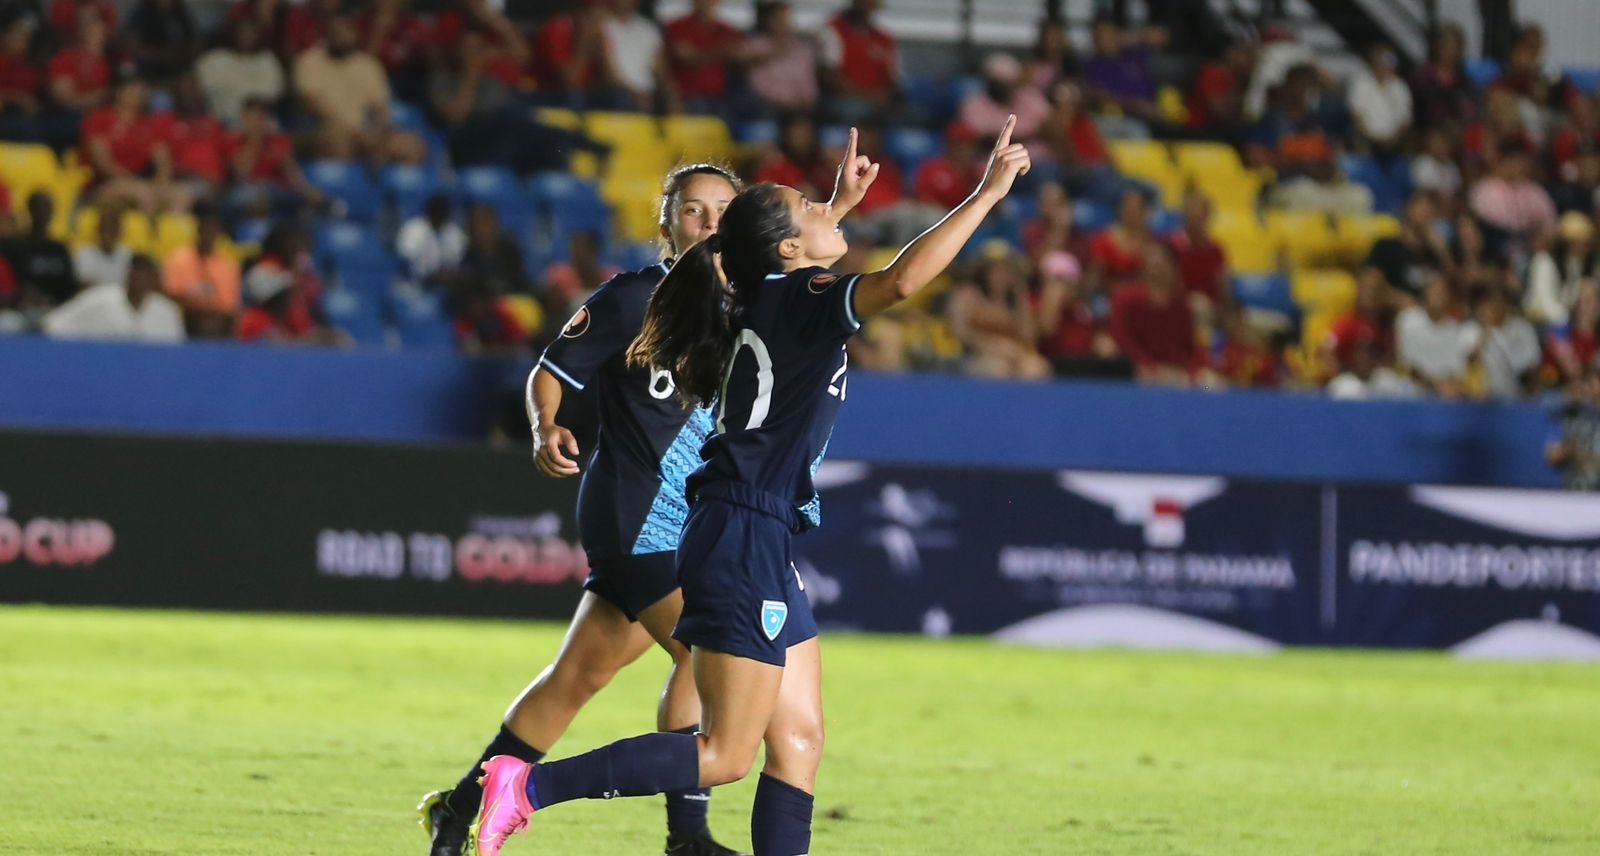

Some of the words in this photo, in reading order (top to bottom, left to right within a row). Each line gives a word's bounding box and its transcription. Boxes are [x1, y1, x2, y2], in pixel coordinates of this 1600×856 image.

[648, 365, 676, 400] 6
[24, 518, 114, 566] CUP
[317, 529, 404, 578] ROAD
[409, 532, 450, 581] TO
